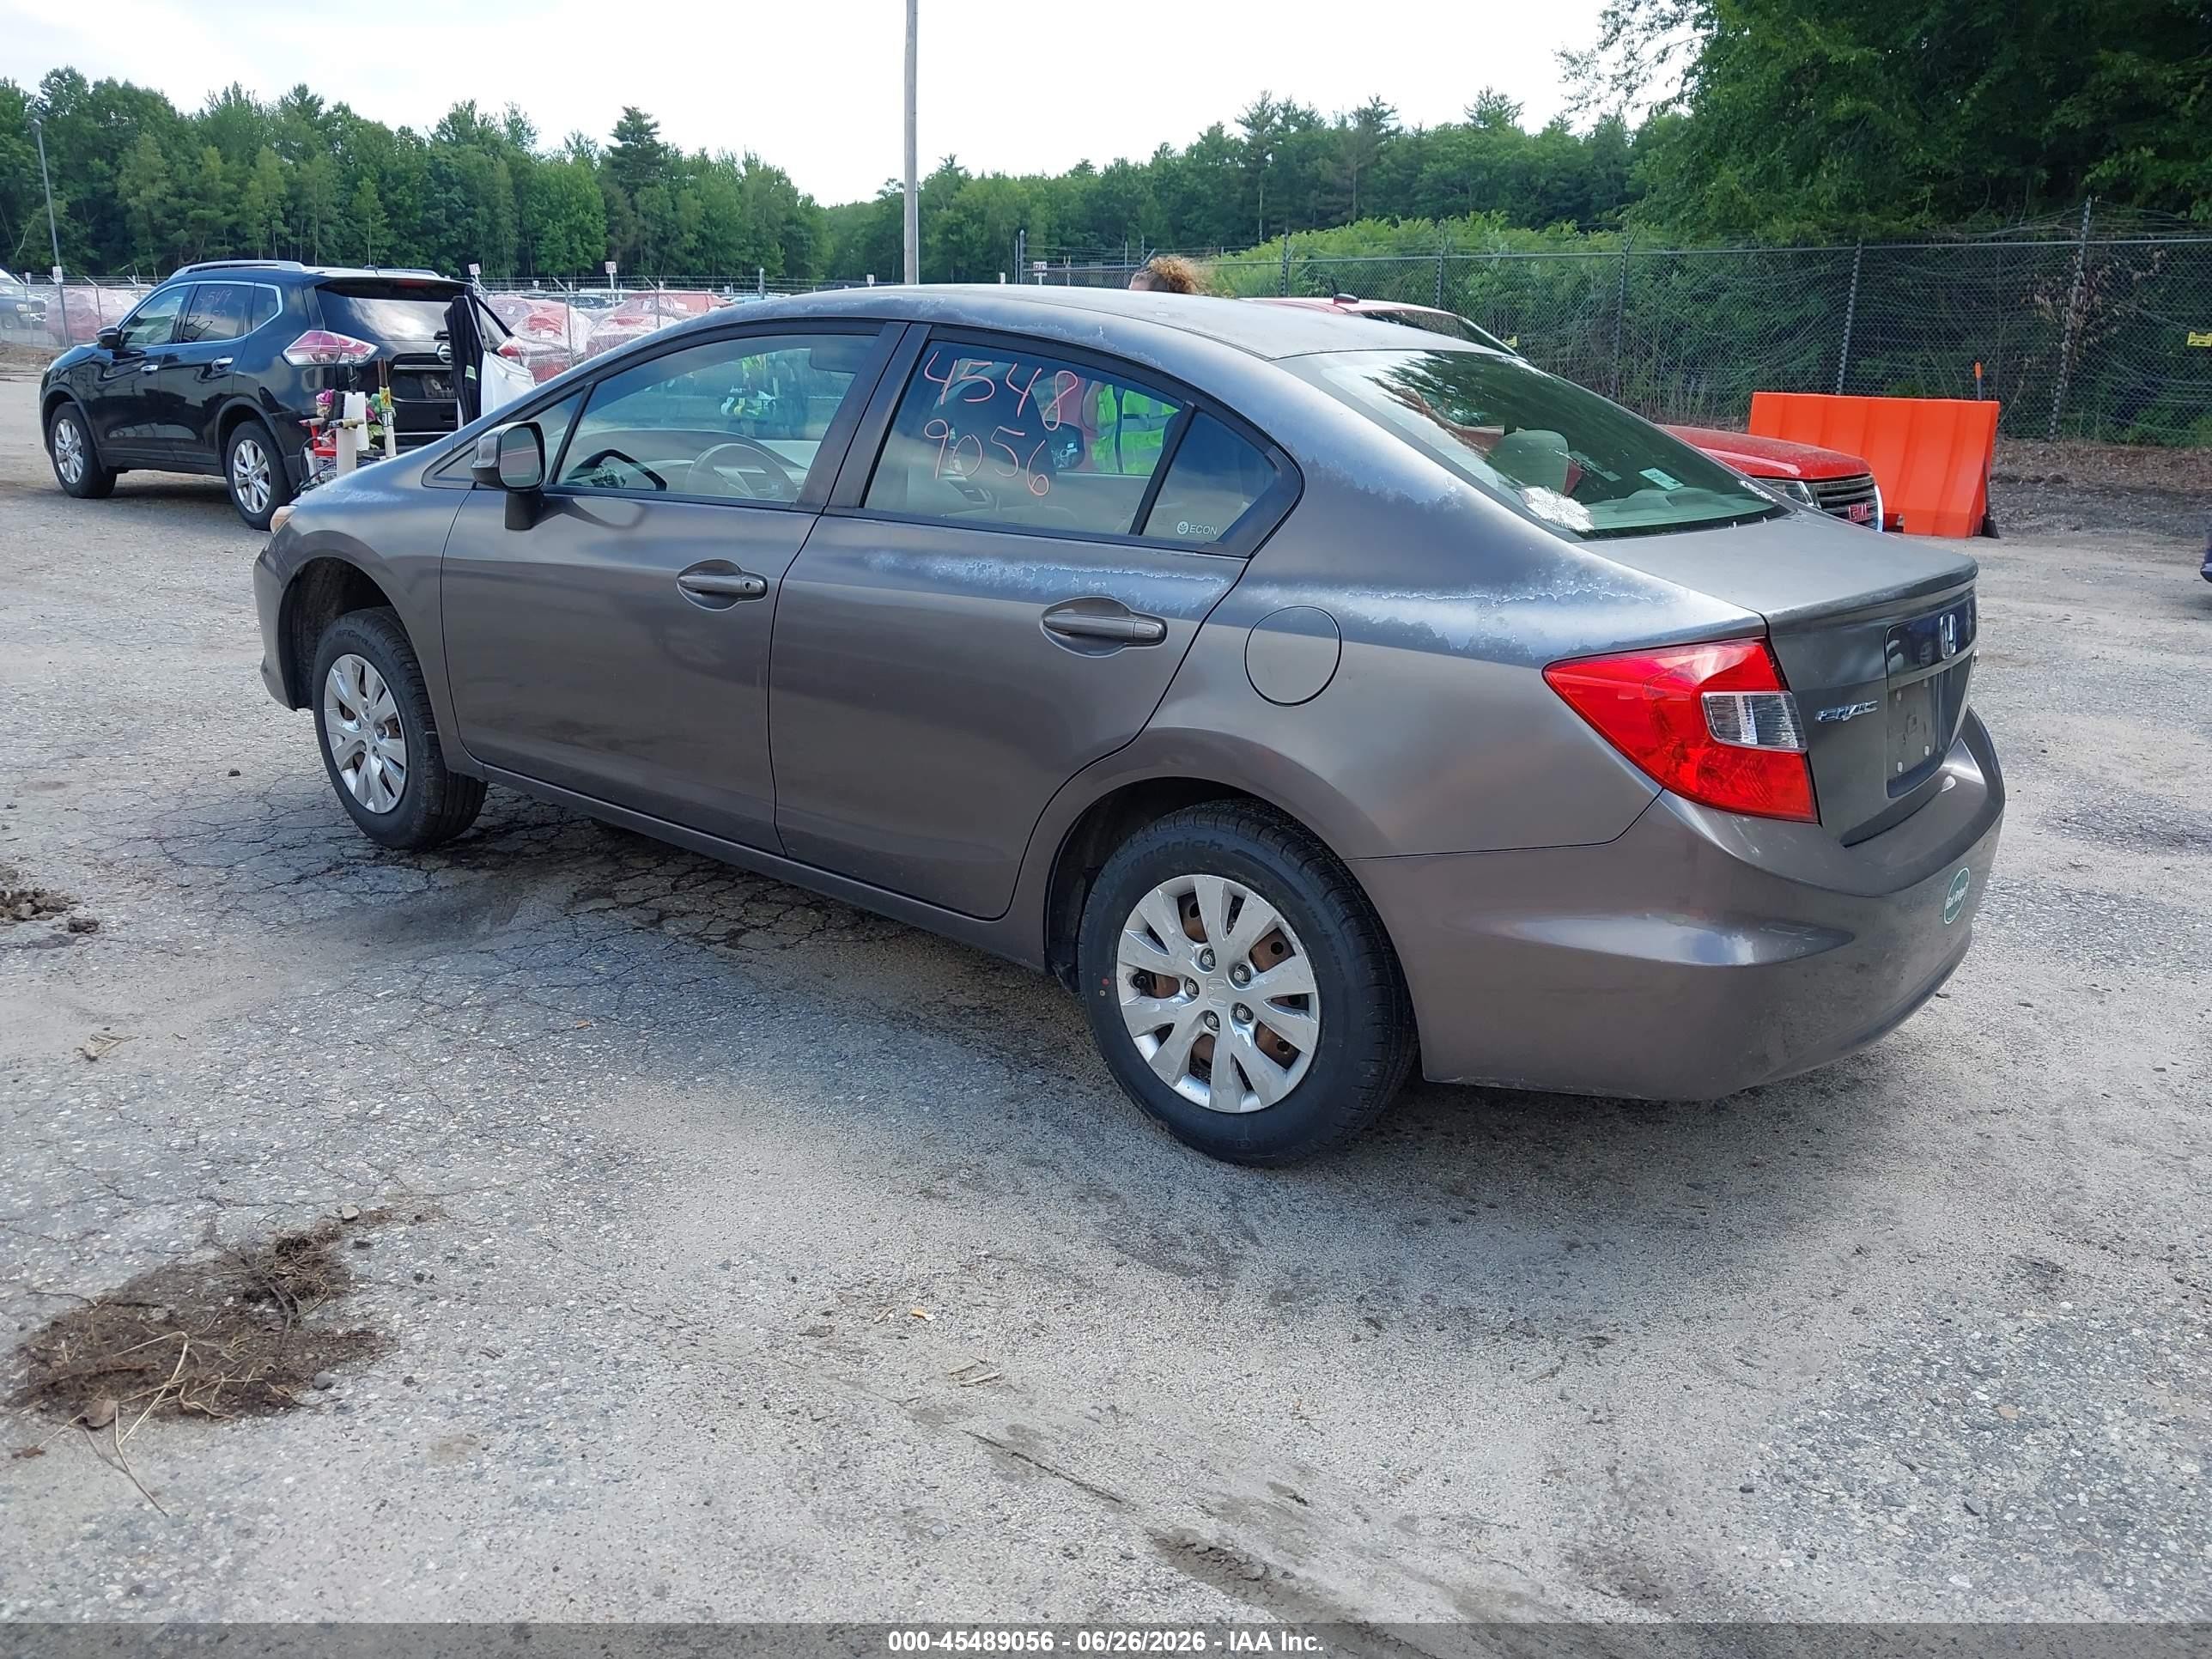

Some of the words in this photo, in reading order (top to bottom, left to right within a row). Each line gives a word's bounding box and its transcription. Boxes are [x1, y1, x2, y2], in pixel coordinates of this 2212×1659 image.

[606, 263, 616, 271] BC
[924, 349, 1079, 431] 4548
[924, 418, 1050, 496] 9056
[1189, 525, 1217, 535] ECON
[1814, 700, 1878, 722] CIVIC
